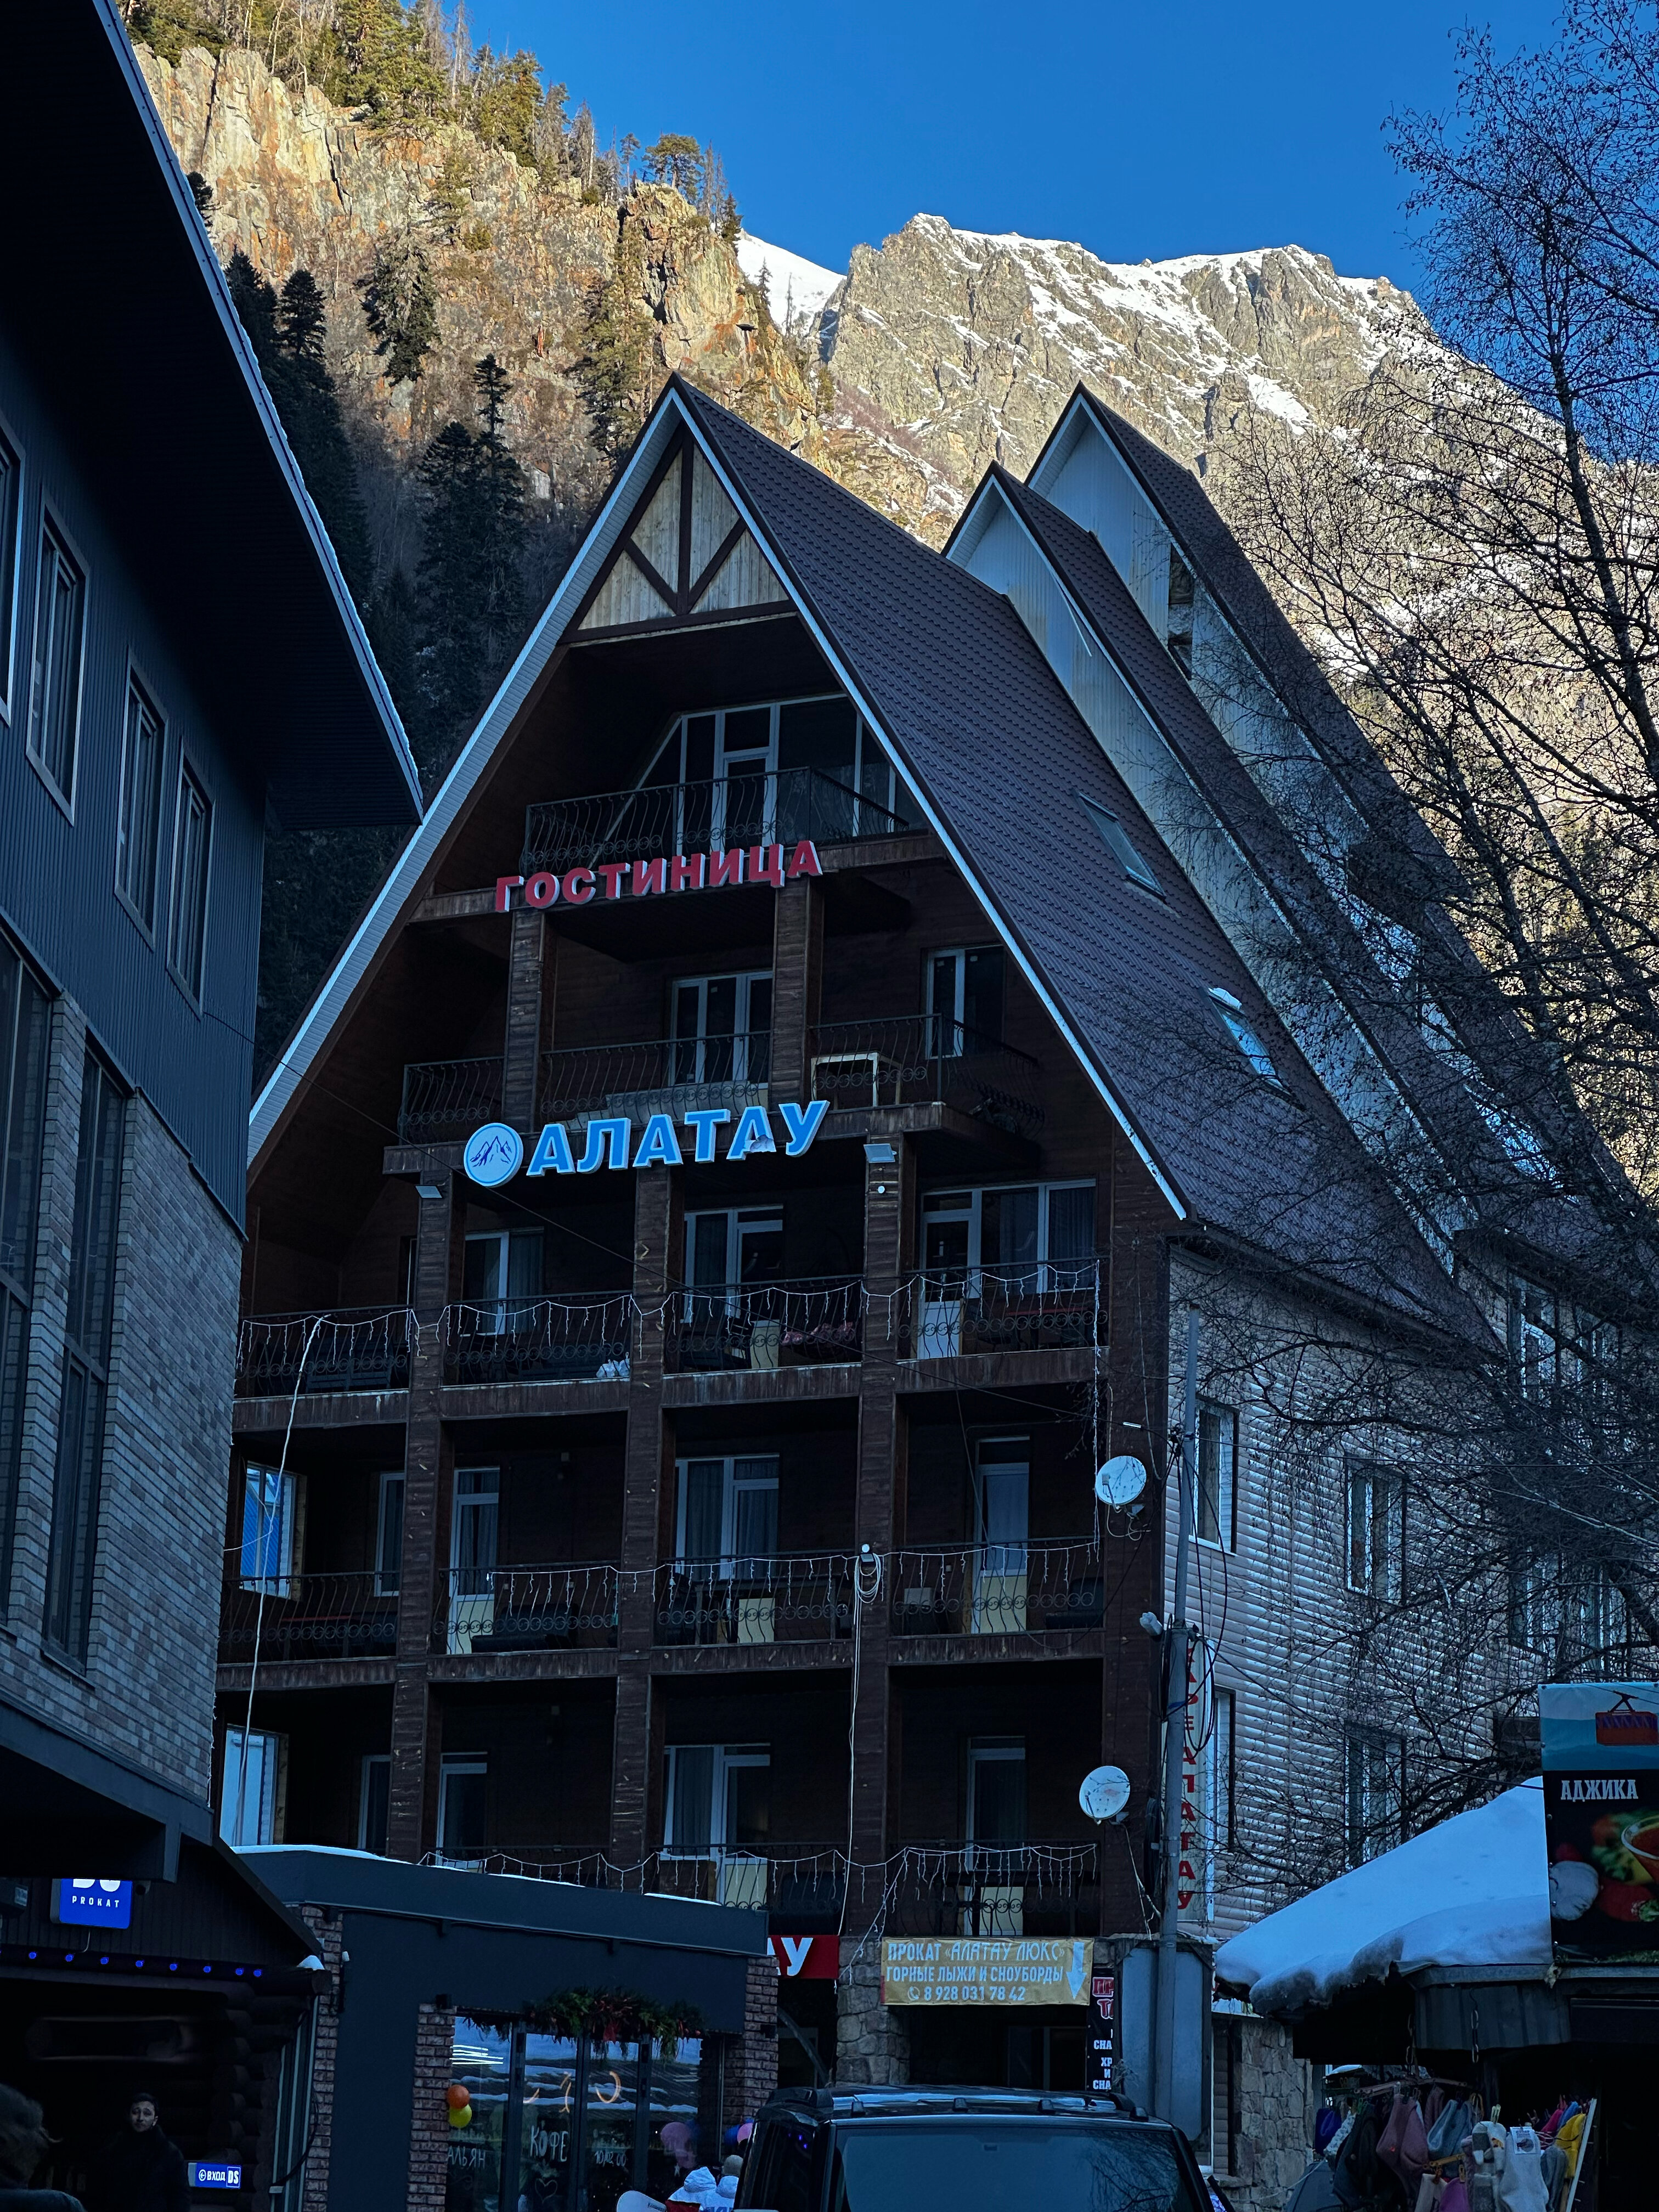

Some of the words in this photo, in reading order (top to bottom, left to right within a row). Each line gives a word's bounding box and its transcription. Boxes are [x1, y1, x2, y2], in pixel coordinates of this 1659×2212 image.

[495, 840, 823, 912] ГОСТИНИЦА
[526, 1100, 830, 1177] АЛАТАУ
[1561, 1779, 1639, 1802] АДЖИКА
[72, 1895, 120, 1908] PROKAT
[888, 1943, 941, 1961] ПРОКАТ
[886, 1966, 934, 1982] ГОРНЫЕ
[938, 1966, 976, 1982] ЛЫЖИ
[979, 1966, 987, 1982] И
[991, 1966, 1064, 1984] СНОУБОРДЫ
[924, 1987, 932, 2001] 8
[935, 1987, 958, 2001] 928
[962, 1986, 985, 2001] 031
[989, 1986, 1006, 2001] 78
[1008, 1987, 1026, 2001] 42
[530, 2124, 569, 2162] КОФЕ
[207, 2170, 226, 2182] ВХОД
[227, 2170, 239, 2184] DS
